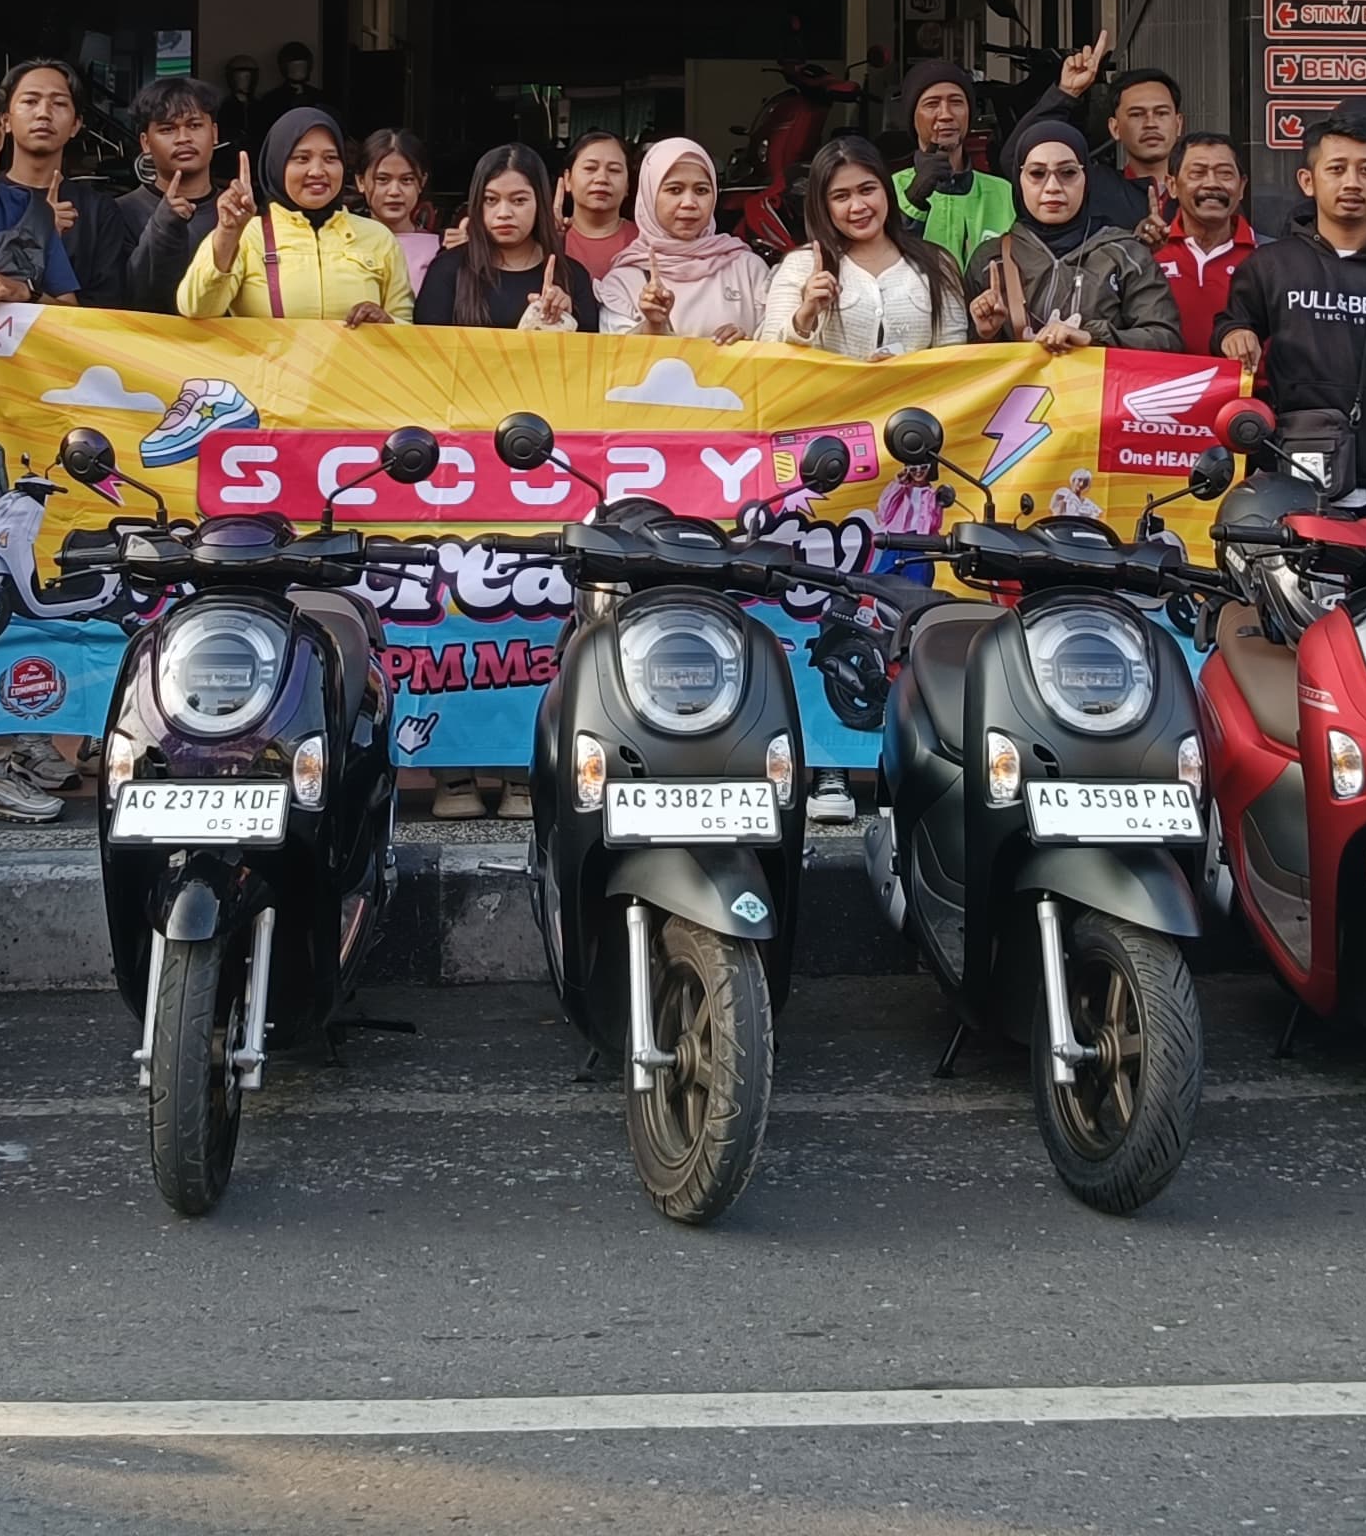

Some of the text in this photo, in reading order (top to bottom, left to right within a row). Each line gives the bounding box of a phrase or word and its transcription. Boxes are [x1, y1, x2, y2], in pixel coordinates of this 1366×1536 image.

[1299, 5, 1351, 24] STNK
[1121, 420, 1215, 438] HONDA
[1119, 448, 1153, 467] One
[126, 789, 281, 810] AG 2373 KDF
[615, 788, 647, 809] AG
[654, 787, 715, 809] 3382
[1038, 787, 1071, 808] AG
[1077, 787, 1139, 809] 3598
